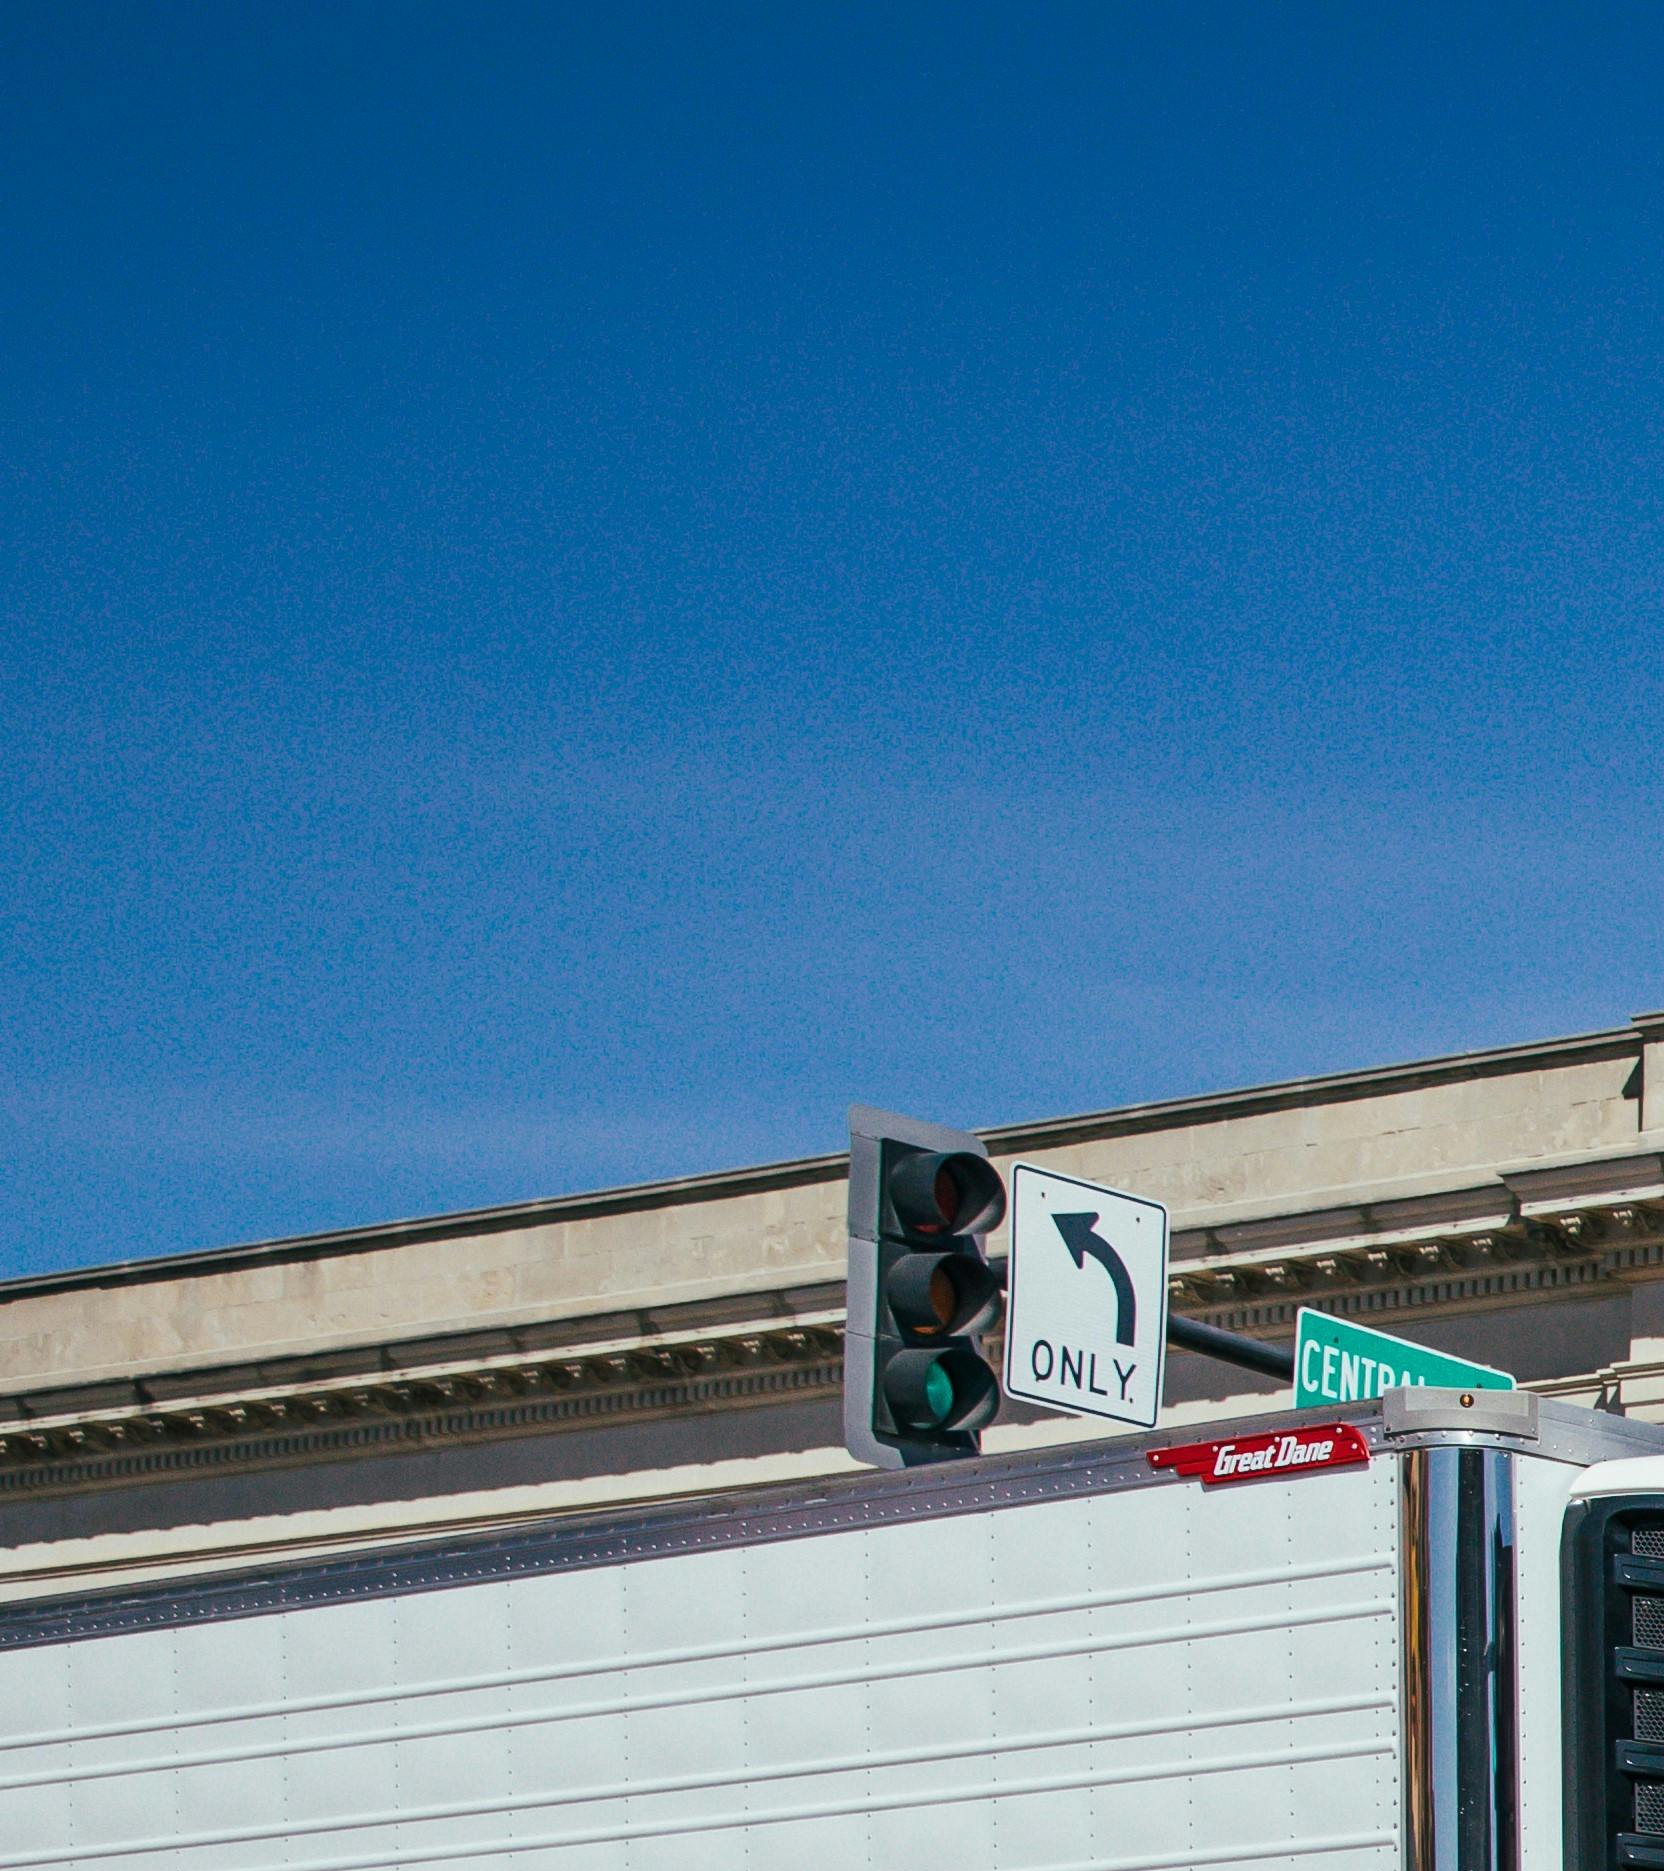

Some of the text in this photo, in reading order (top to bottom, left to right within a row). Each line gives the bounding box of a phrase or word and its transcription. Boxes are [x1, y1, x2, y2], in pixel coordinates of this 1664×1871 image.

[1032, 1339, 1137, 1401] ONLY
[1213, 1435, 1333, 1477] Great Dane
